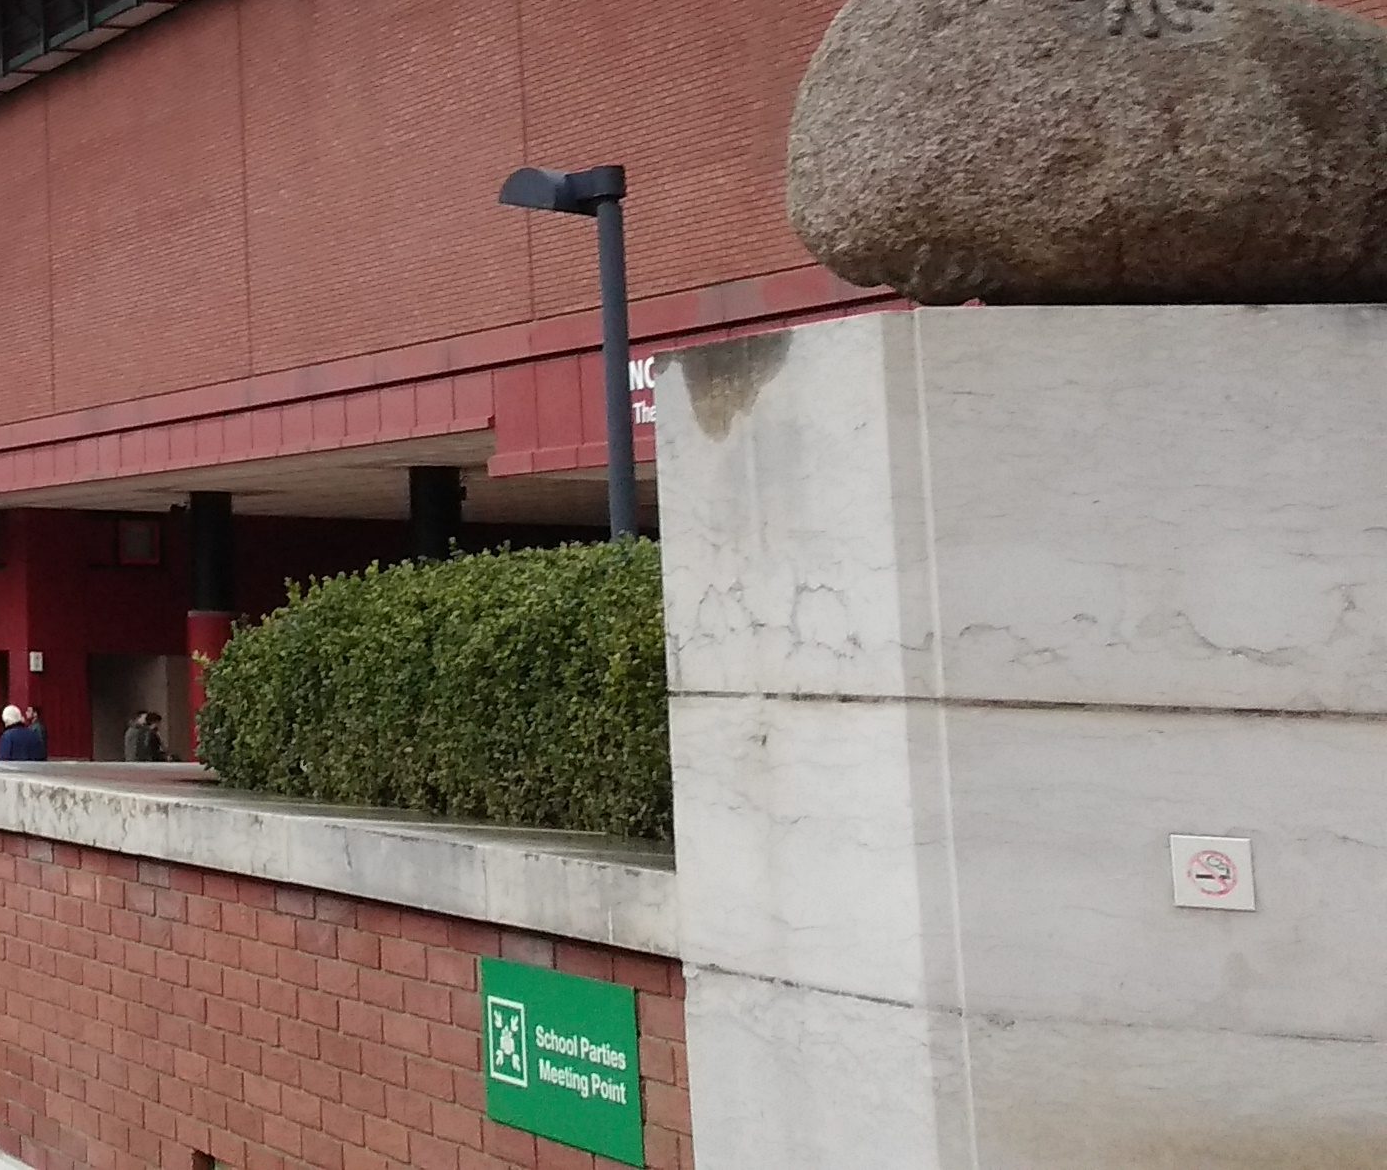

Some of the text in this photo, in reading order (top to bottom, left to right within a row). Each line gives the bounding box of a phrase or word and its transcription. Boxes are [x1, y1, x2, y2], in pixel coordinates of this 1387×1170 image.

[535, 1024, 626, 1070] School Parties
[538, 1058, 627, 1105] Meeting Point
